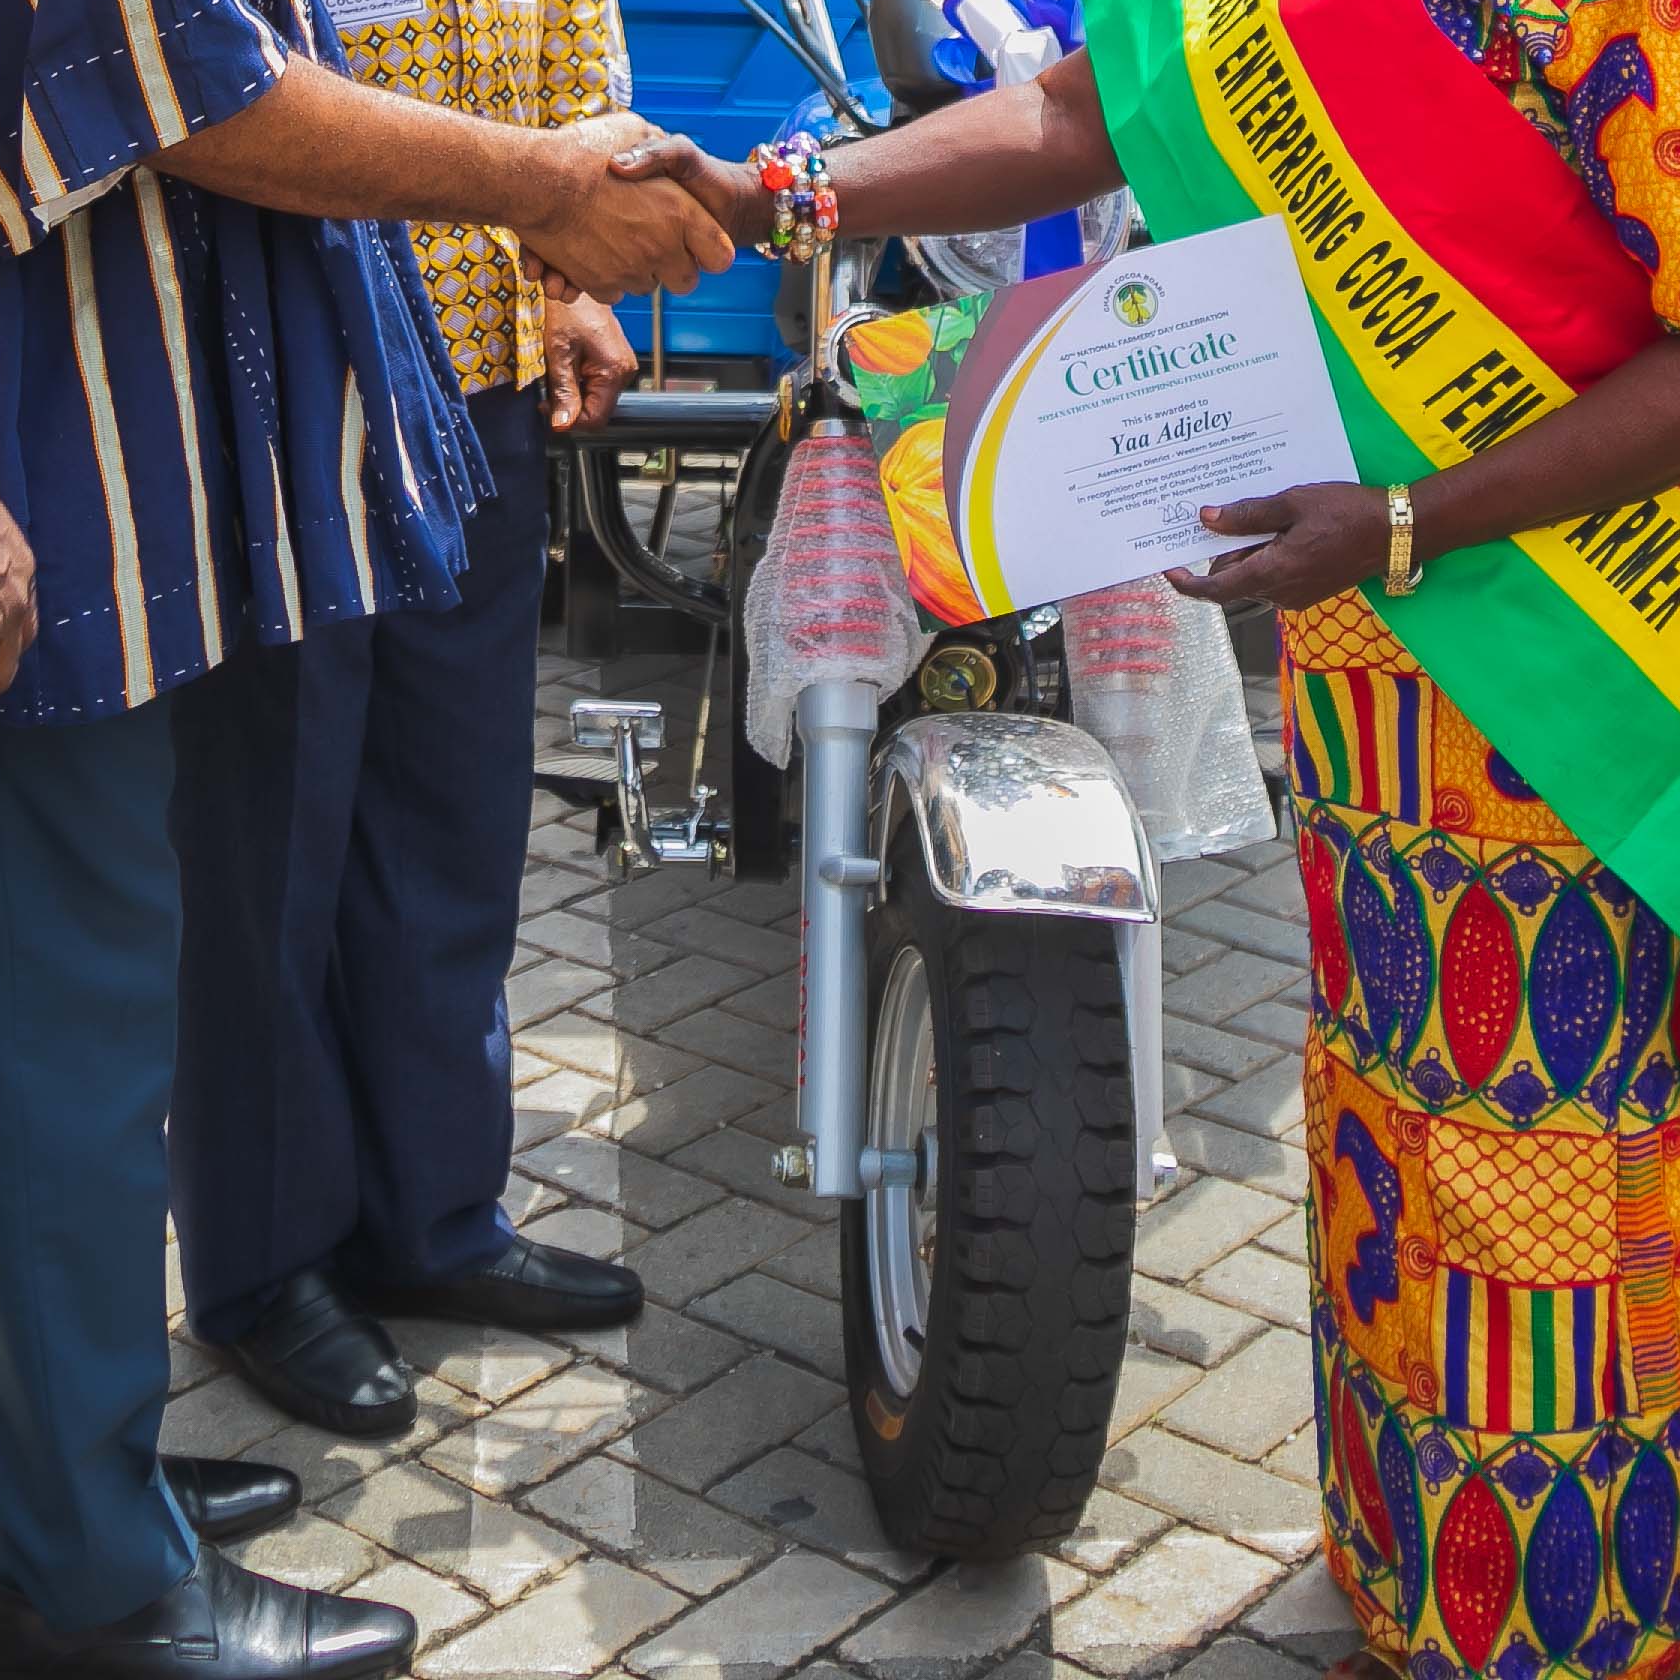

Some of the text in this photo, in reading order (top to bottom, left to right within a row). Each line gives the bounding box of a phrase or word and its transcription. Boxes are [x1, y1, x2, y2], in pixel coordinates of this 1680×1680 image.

[1214, 23, 1365, 262] ENTERPRISING
[1335, 240, 1457, 370] COCOA
[1422, 348, 1547, 455] FEM
[1104, 273, 1166, 312] GHANA COCOA BOARD
[1077, 342, 1117, 357] NATIONAL
[1158, 326, 1174, 336] DAY
[1175, 310, 1229, 331] CELEBRATION
[1065, 332, 1238, 397] Certificate
[1038, 413, 1058, 424] 2024
[1057, 400, 1099, 418] NATIONAL
[1101, 393, 1124, 406] MOST
[1216, 361, 1245, 375] COCOA
[1122, 398, 1209, 428] This is awarded to
[1110, 410, 1232, 456] Yaa Adjeley
[1143, 452, 1170, 467] District
[1176, 444, 1207, 458] Western
[1208, 438, 1230, 450] South
[1231, 430, 1258, 443] Region
[1068, 484, 1076, 492] of
[1087, 483, 1134, 502] recognition
[1135, 479, 1144, 489] of
[1145, 476, 1159, 486] the
[1160, 461, 1210, 481] outstanding
[1211, 448, 1261, 468] contribution
[1262, 446, 1272, 455] to
[1273, 441, 1287, 451] the
[1104, 486, 1158, 507] development
[1159, 482, 1169, 492] of
[1169, 473, 1201, 488] Ghana's
[1203, 467, 1228, 480] Cocoa
[1100, 506, 1125, 518] Given
[1125, 500, 1141, 511] this
[1172, 481, 1214, 499] November
[1239, 470, 1249, 480] in
[1134, 537, 1155, 551] Hon
[1156, 527, 1191, 545] Joseph
[1165, 536, 1191, 552] Chief
